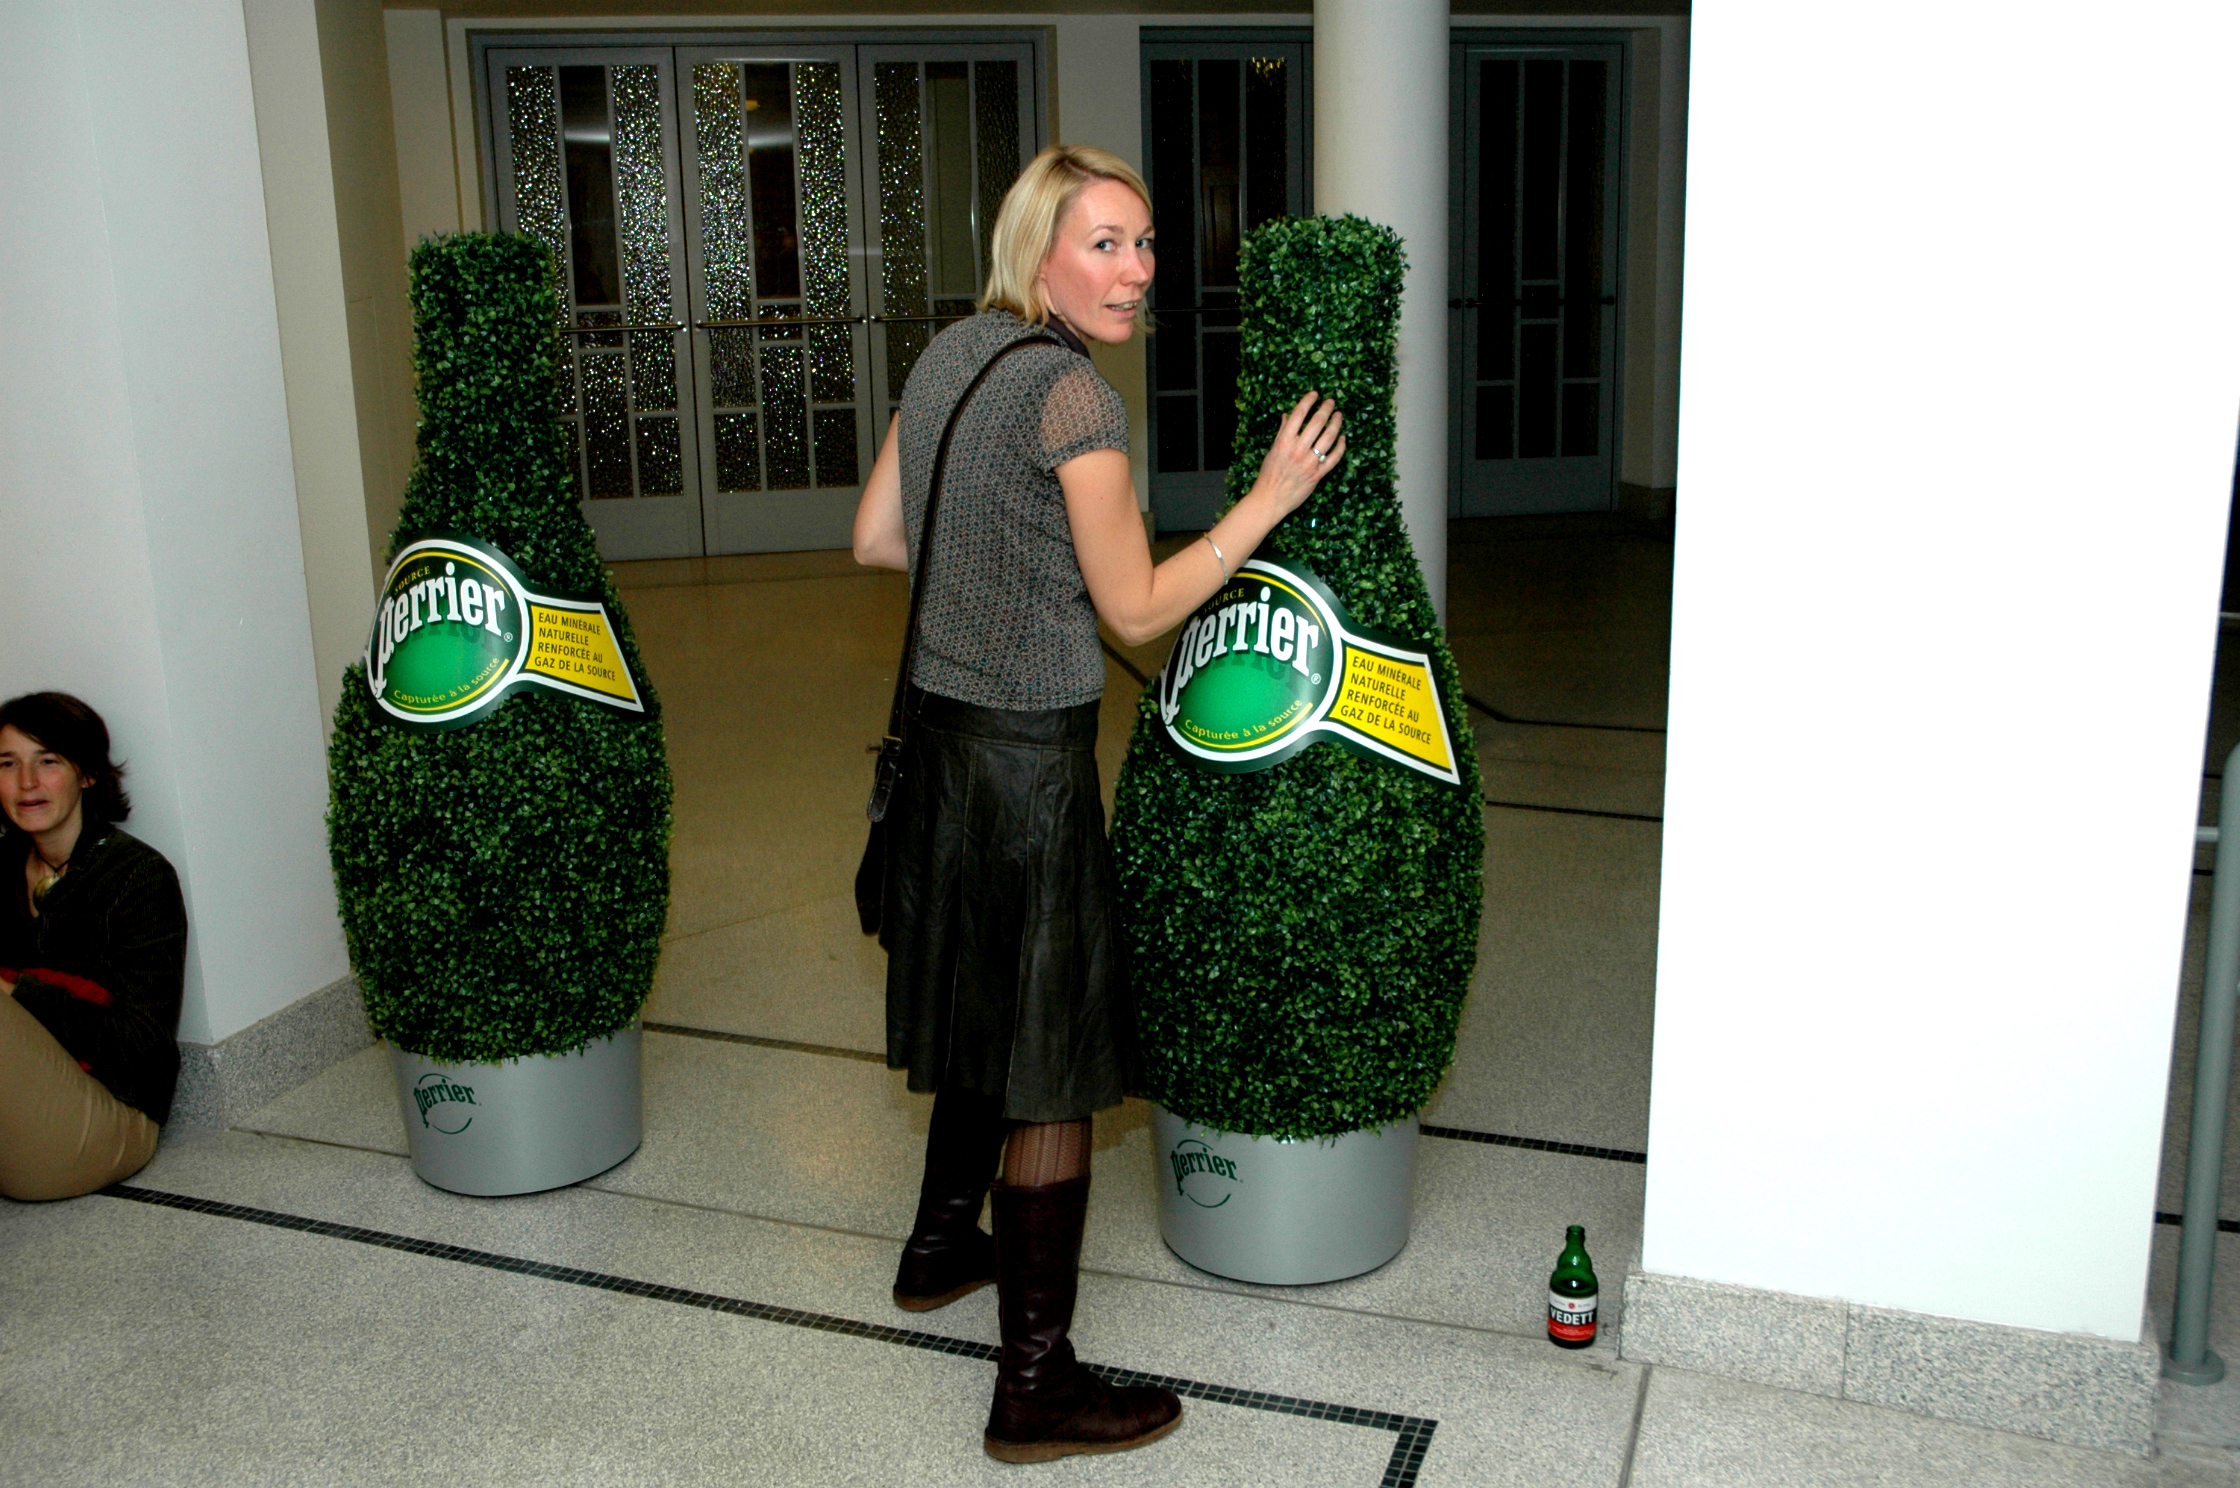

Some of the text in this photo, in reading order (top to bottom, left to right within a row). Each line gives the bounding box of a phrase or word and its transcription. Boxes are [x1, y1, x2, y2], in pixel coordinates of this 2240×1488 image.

[394, 566, 430, 595] SOURCE
[538, 612, 601, 635] EAU MINÉRALE
[539, 627, 589, 646] NATURELLE
[538, 642, 603, 663] RENFORCÉE AU
[394, 657, 499, 704] Capturée à la source
[534, 656, 616, 681] GAZ DE LA SOURCE
[1352, 656, 1422, 691] EAU MINÉRALE
[1350, 673, 1406, 701] NATURELLE
[1185, 699, 1303, 740] Capturée à la source
[1346, 689, 1419, 723] RENFORCÉE AU
[1340, 705, 1431, 745] GAZ DE LA SOURCE
[1550, 1306, 1594, 1326] VEDETT
